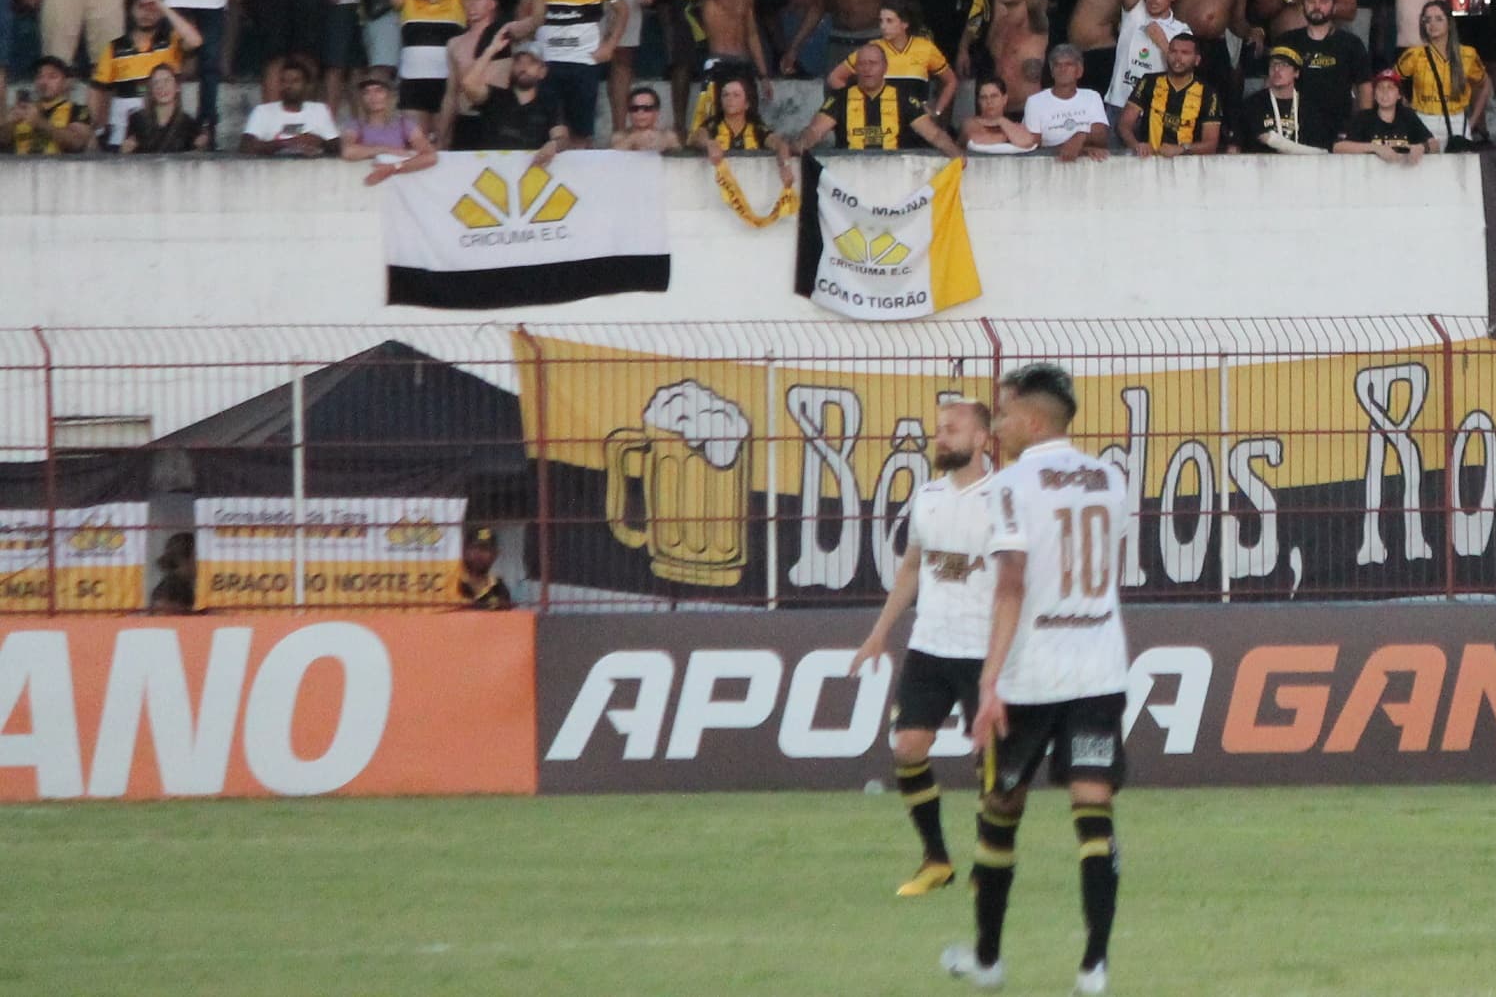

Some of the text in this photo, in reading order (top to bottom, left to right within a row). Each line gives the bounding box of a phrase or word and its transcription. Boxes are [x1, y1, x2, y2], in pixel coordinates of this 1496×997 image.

[831, 188, 859, 208] RIO
[869, 288, 928, 309] TIGRÃO
[1054, 504, 1111, 599] 10
[545, 646, 1213, 761] APOA
